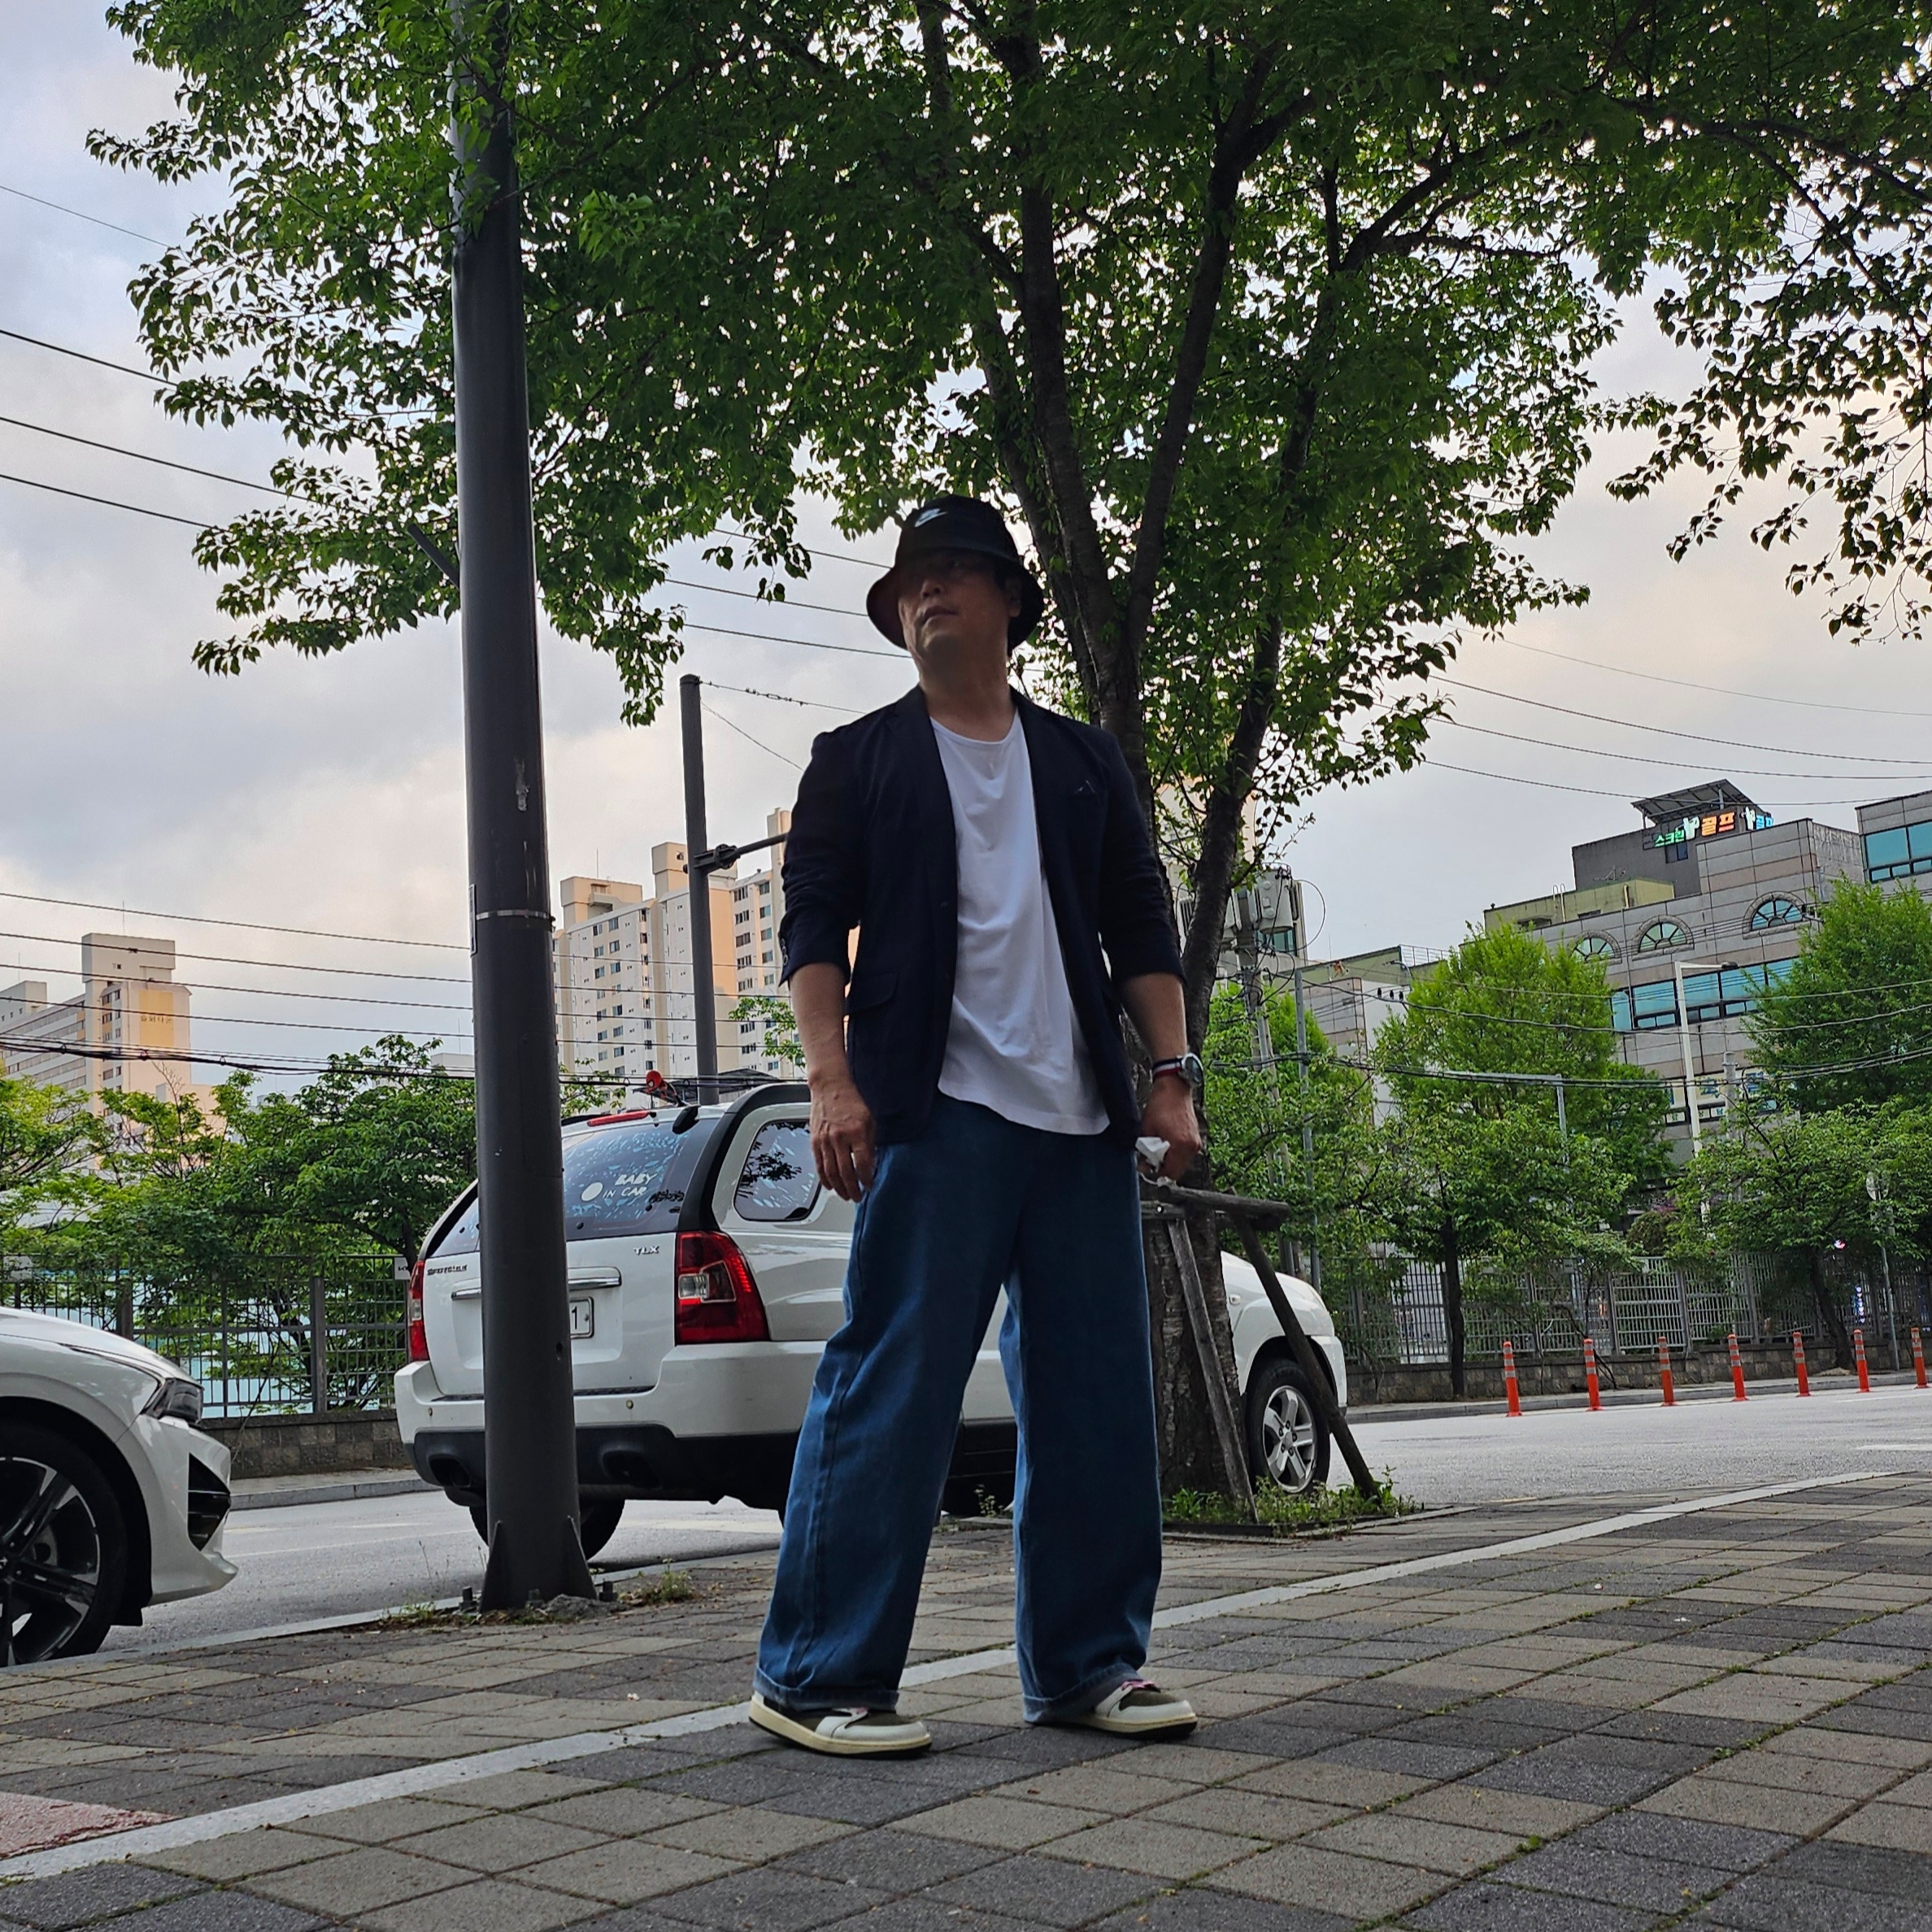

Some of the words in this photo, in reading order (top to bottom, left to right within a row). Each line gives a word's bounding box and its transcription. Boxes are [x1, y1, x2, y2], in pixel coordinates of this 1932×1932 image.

[1655, 829, 1685, 847] 스크린
[1701, 812, 1735, 837] 골프
[614, 1173, 658, 1186] BABY
[603, 1190, 616, 1199] IN
[620, 1186, 647, 1197] CAR
[633, 1245, 660, 1255] TLX
